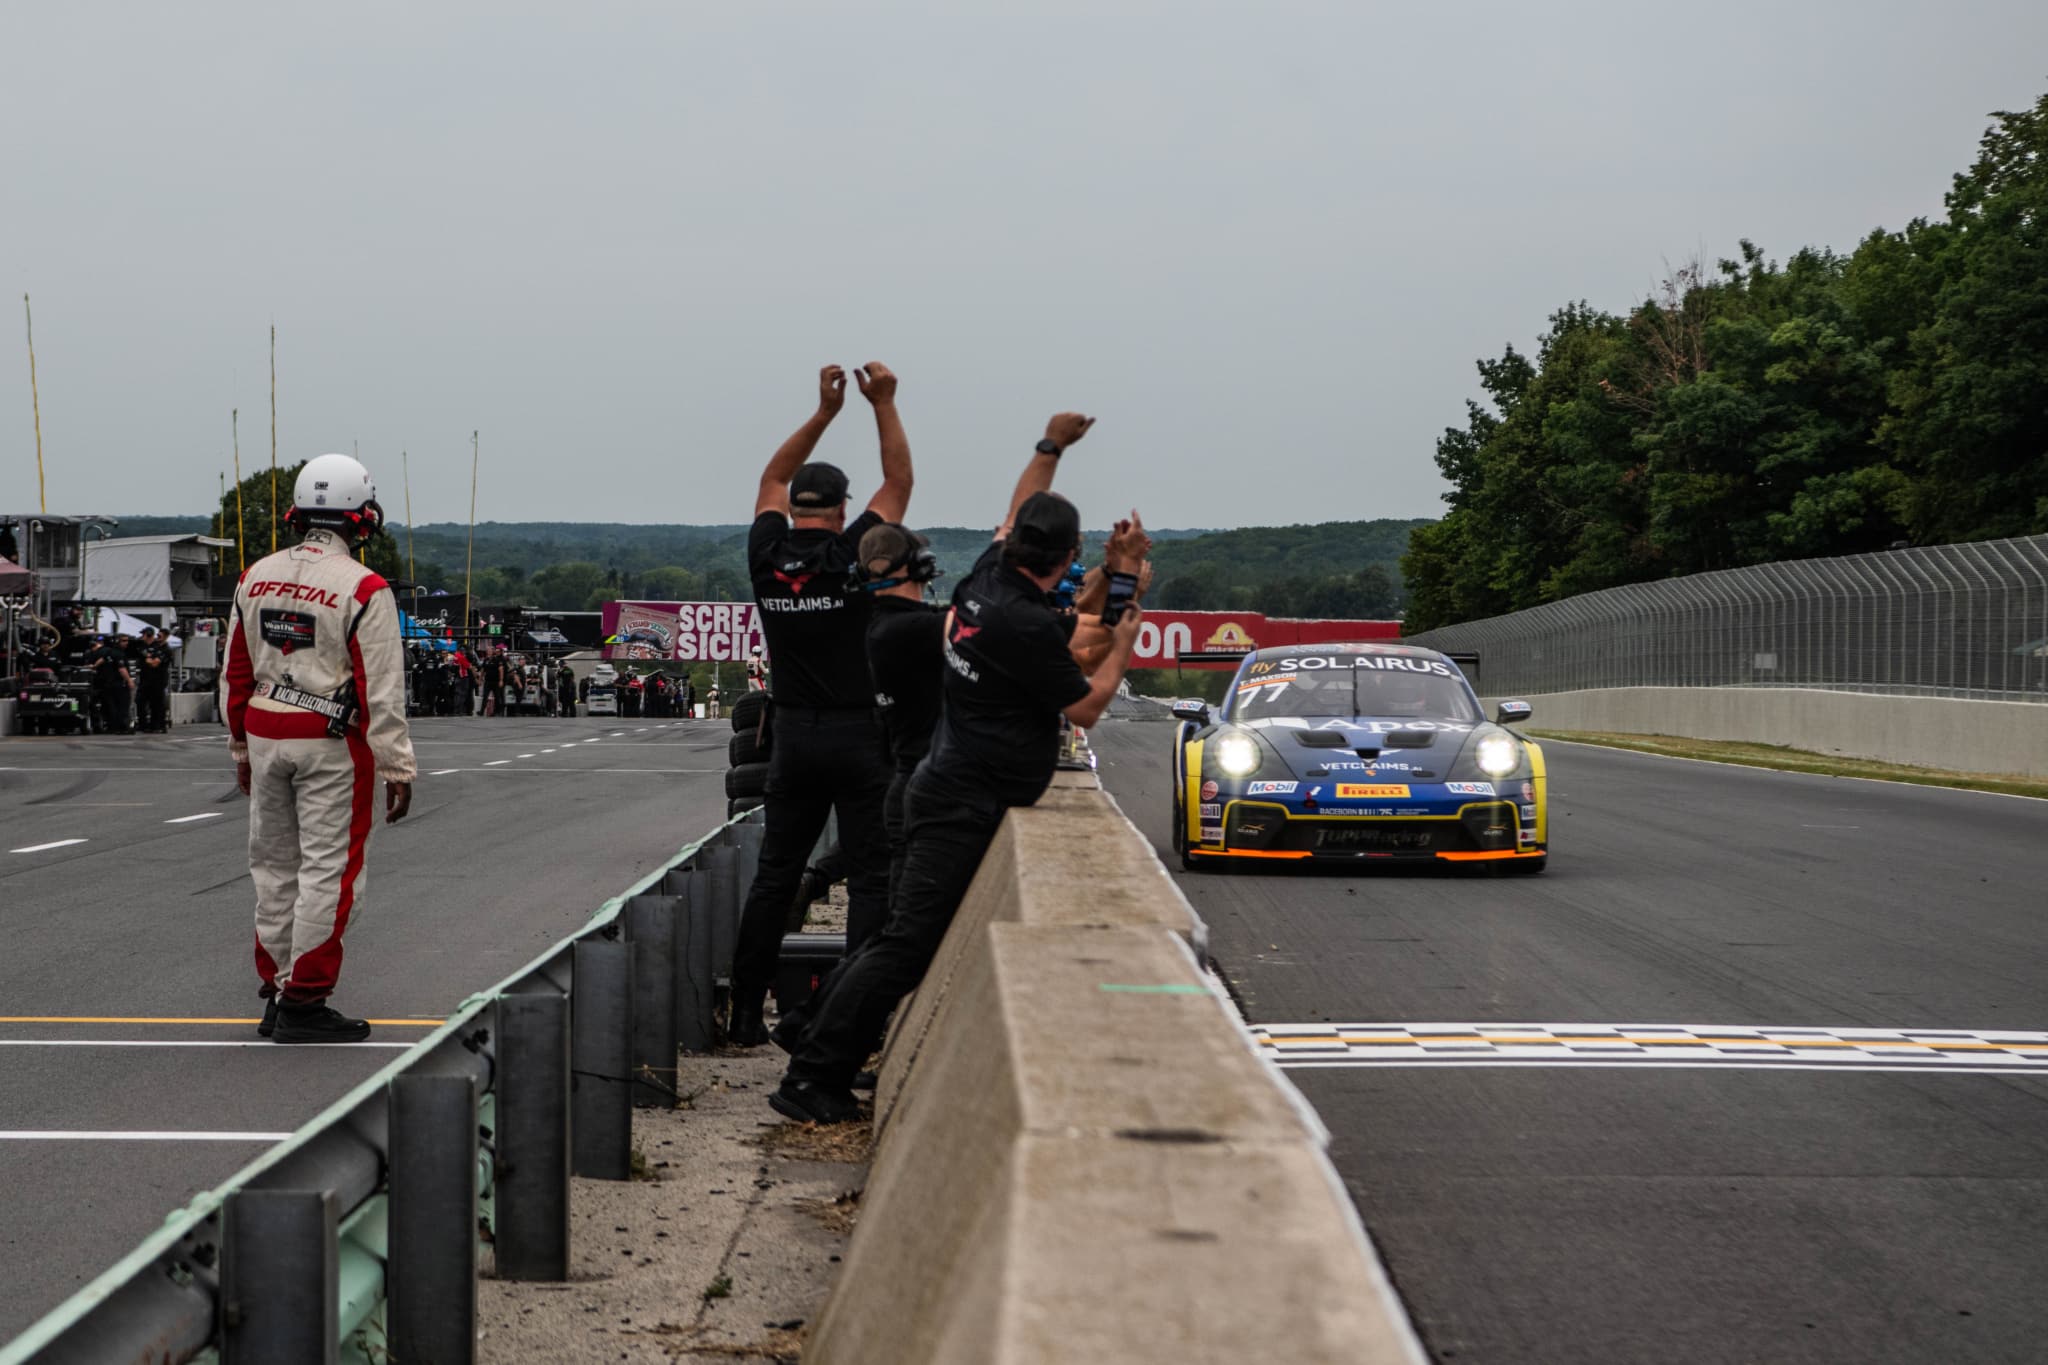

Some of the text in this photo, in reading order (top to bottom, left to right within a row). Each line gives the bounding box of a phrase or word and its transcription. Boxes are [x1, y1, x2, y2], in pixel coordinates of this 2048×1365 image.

[761, 597, 844, 611] VETCLAIMS.AI
[1250, 656, 1451, 676] fly SOLAIRUS
[1237, 681, 1290, 709] 77
[274, 686, 345, 719] RACING ELECTRONICS
[1251, 783, 1295, 793] Mobil
[1343, 786, 1404, 795] PIRELLI
[1449, 783, 1493, 793] Mobil
